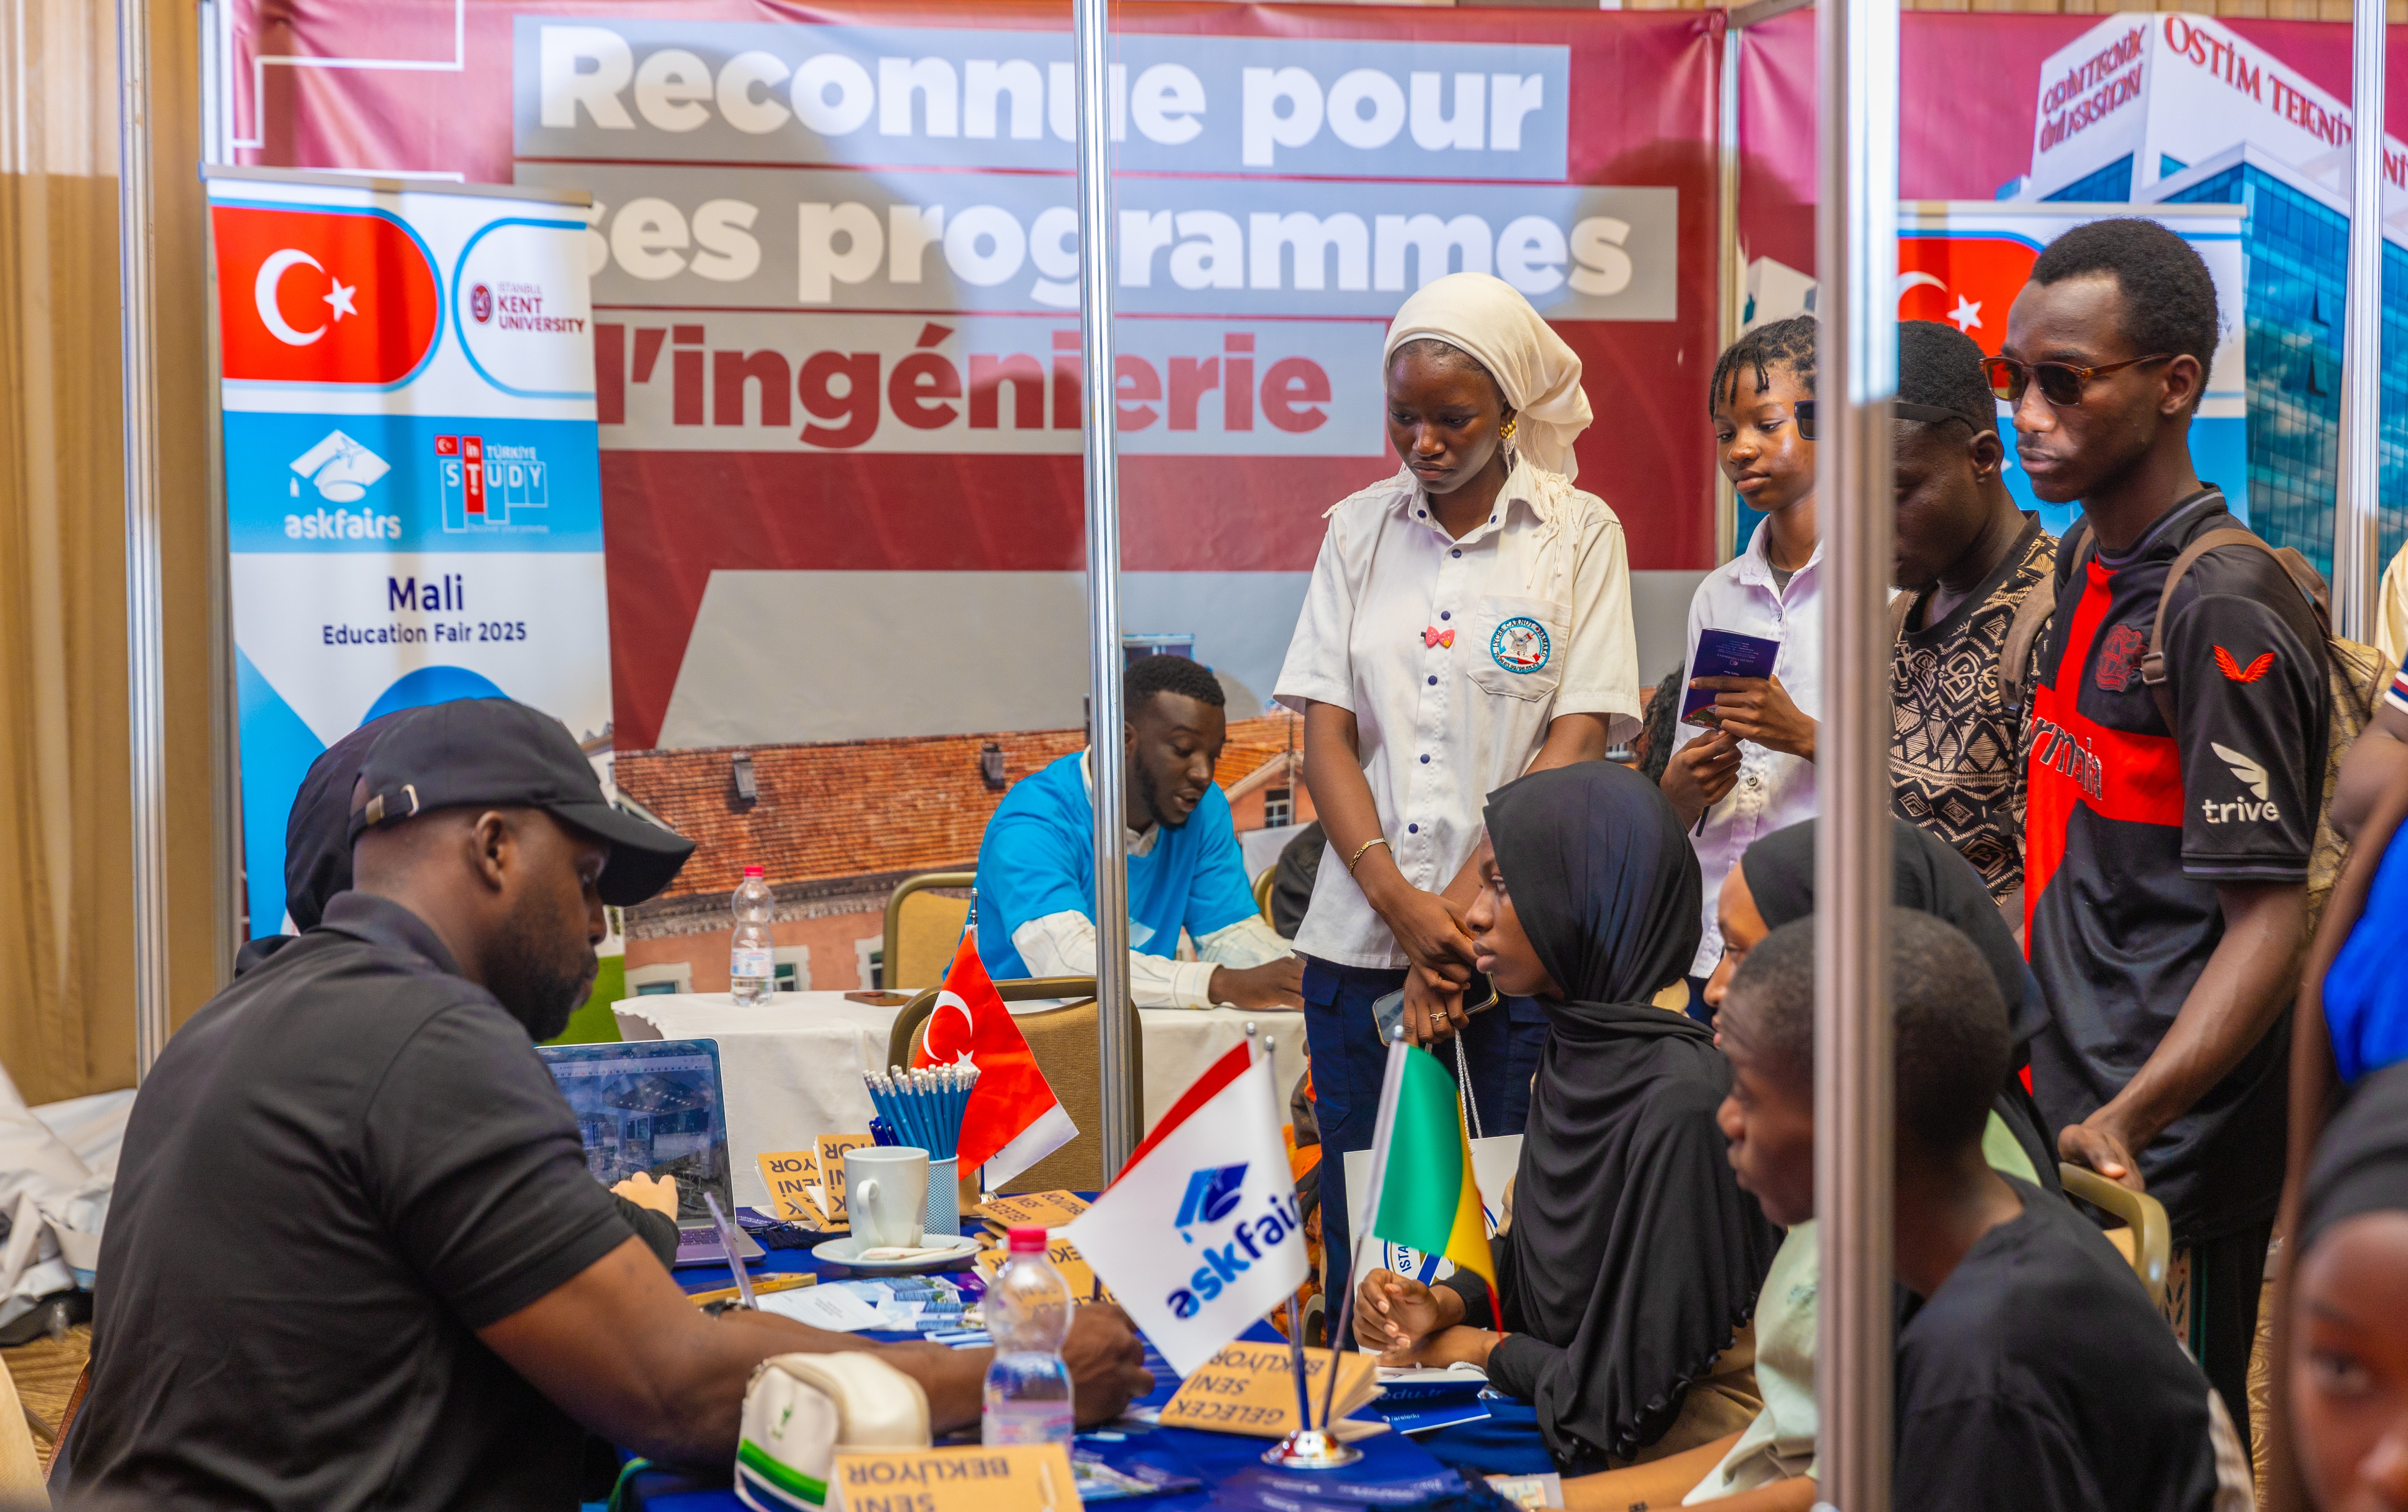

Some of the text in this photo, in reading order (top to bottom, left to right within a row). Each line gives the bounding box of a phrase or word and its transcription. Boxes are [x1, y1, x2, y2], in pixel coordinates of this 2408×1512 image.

[1242, 65, 1543, 168] pour
[797, 202, 1633, 309] programmes
[498, 297, 543, 313] KENT
[499, 316, 585, 334] UNIVERSITY
[486, 443, 536, 460] TÜRKİYE
[284, 507, 402, 539] askfairs
[388, 574, 464, 612] Mali
[322, 622, 527, 645] Education Fair 2025
[1493, 627, 1505, 648] LYCEE
[1505, 619, 1535, 628] CARNOT
[2201, 796, 2280, 824] trive
[1184, 1373, 1251, 1395] SENİ
[1168, 1398, 1285, 1426] GELECEK
[847, 1456, 1010, 1488] BEKLİYOR
